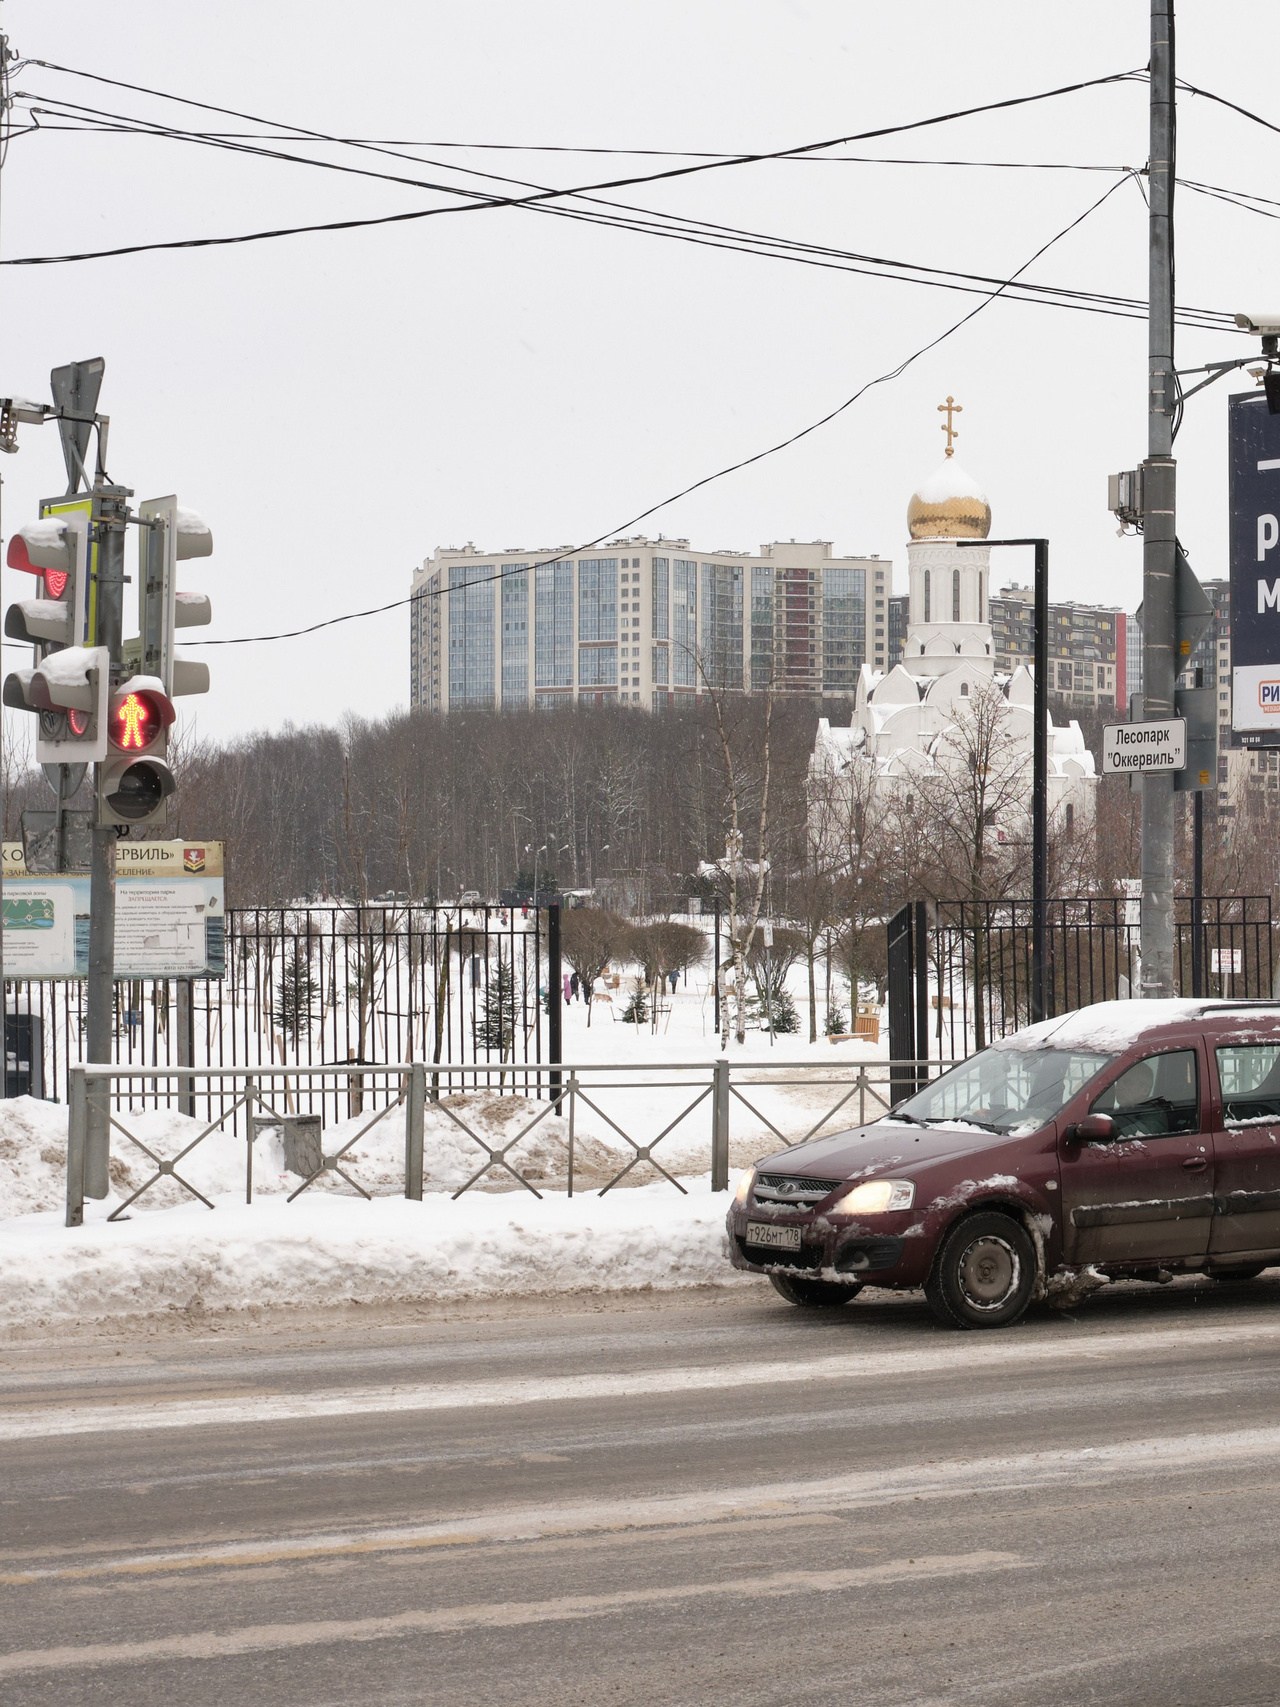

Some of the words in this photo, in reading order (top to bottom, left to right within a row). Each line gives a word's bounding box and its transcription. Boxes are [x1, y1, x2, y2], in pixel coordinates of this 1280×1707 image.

[1116, 729, 1170, 746] Лесопарк
[749, 1226, 783, 1244] Т926МТ
[785, 1228, 799, 1241] 178
